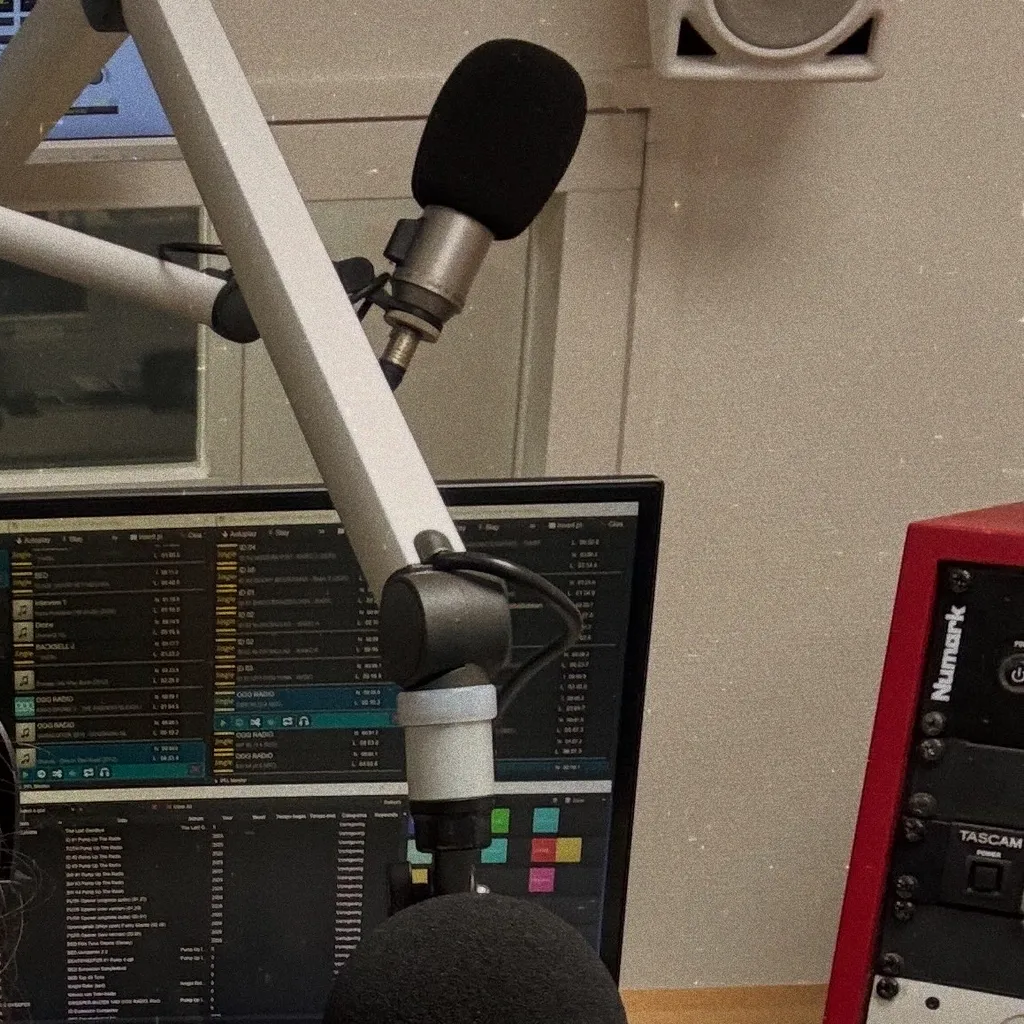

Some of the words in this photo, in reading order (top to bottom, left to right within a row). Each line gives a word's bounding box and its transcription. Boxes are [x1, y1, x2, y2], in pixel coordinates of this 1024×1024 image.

[930, 604, 967, 702] Numark
[959, 829, 1024, 850] TASCAM
[976, 849, 1002, 859] POWER
